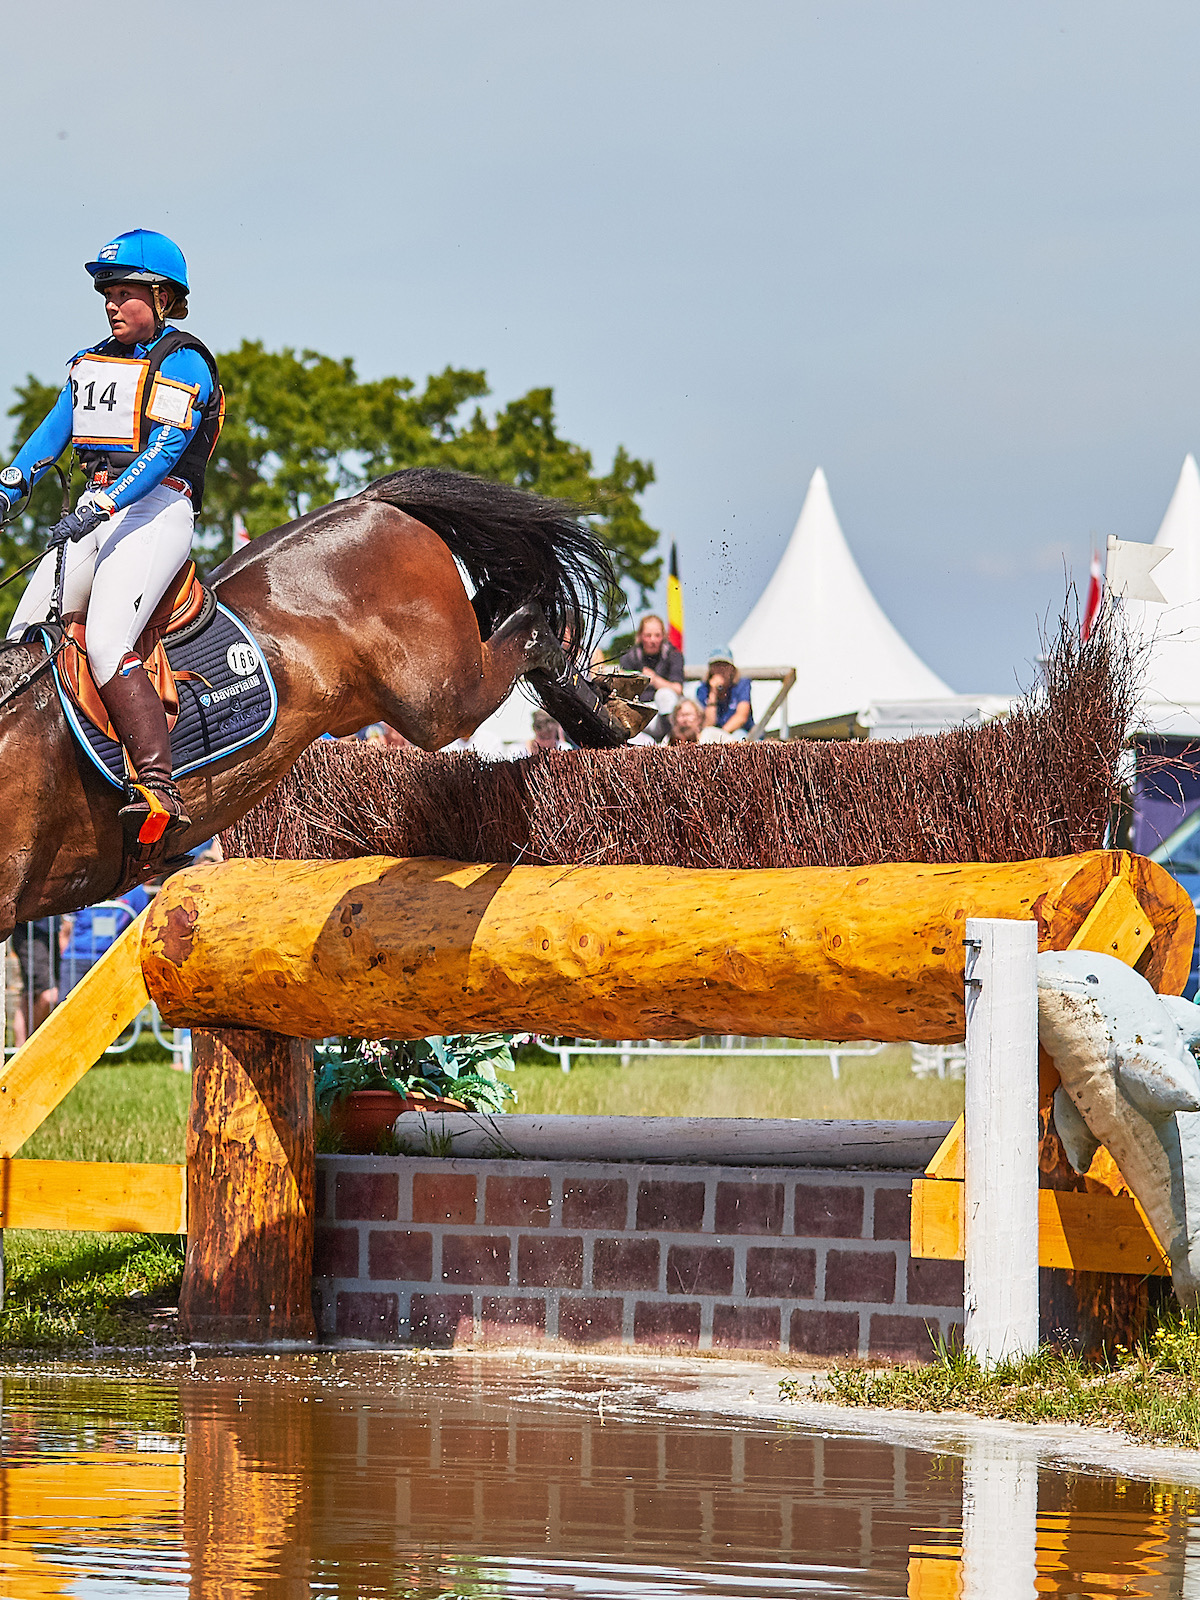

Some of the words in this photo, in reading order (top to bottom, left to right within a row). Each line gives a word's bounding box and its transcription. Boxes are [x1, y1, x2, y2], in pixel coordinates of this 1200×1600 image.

[108, 475, 135, 500] avaria
[131, 461, 146, 476] 0.0
[157, 425, 172, 442] Tea
[232, 650, 255, 669] 166
[210, 680, 249, 703] Bavaria
